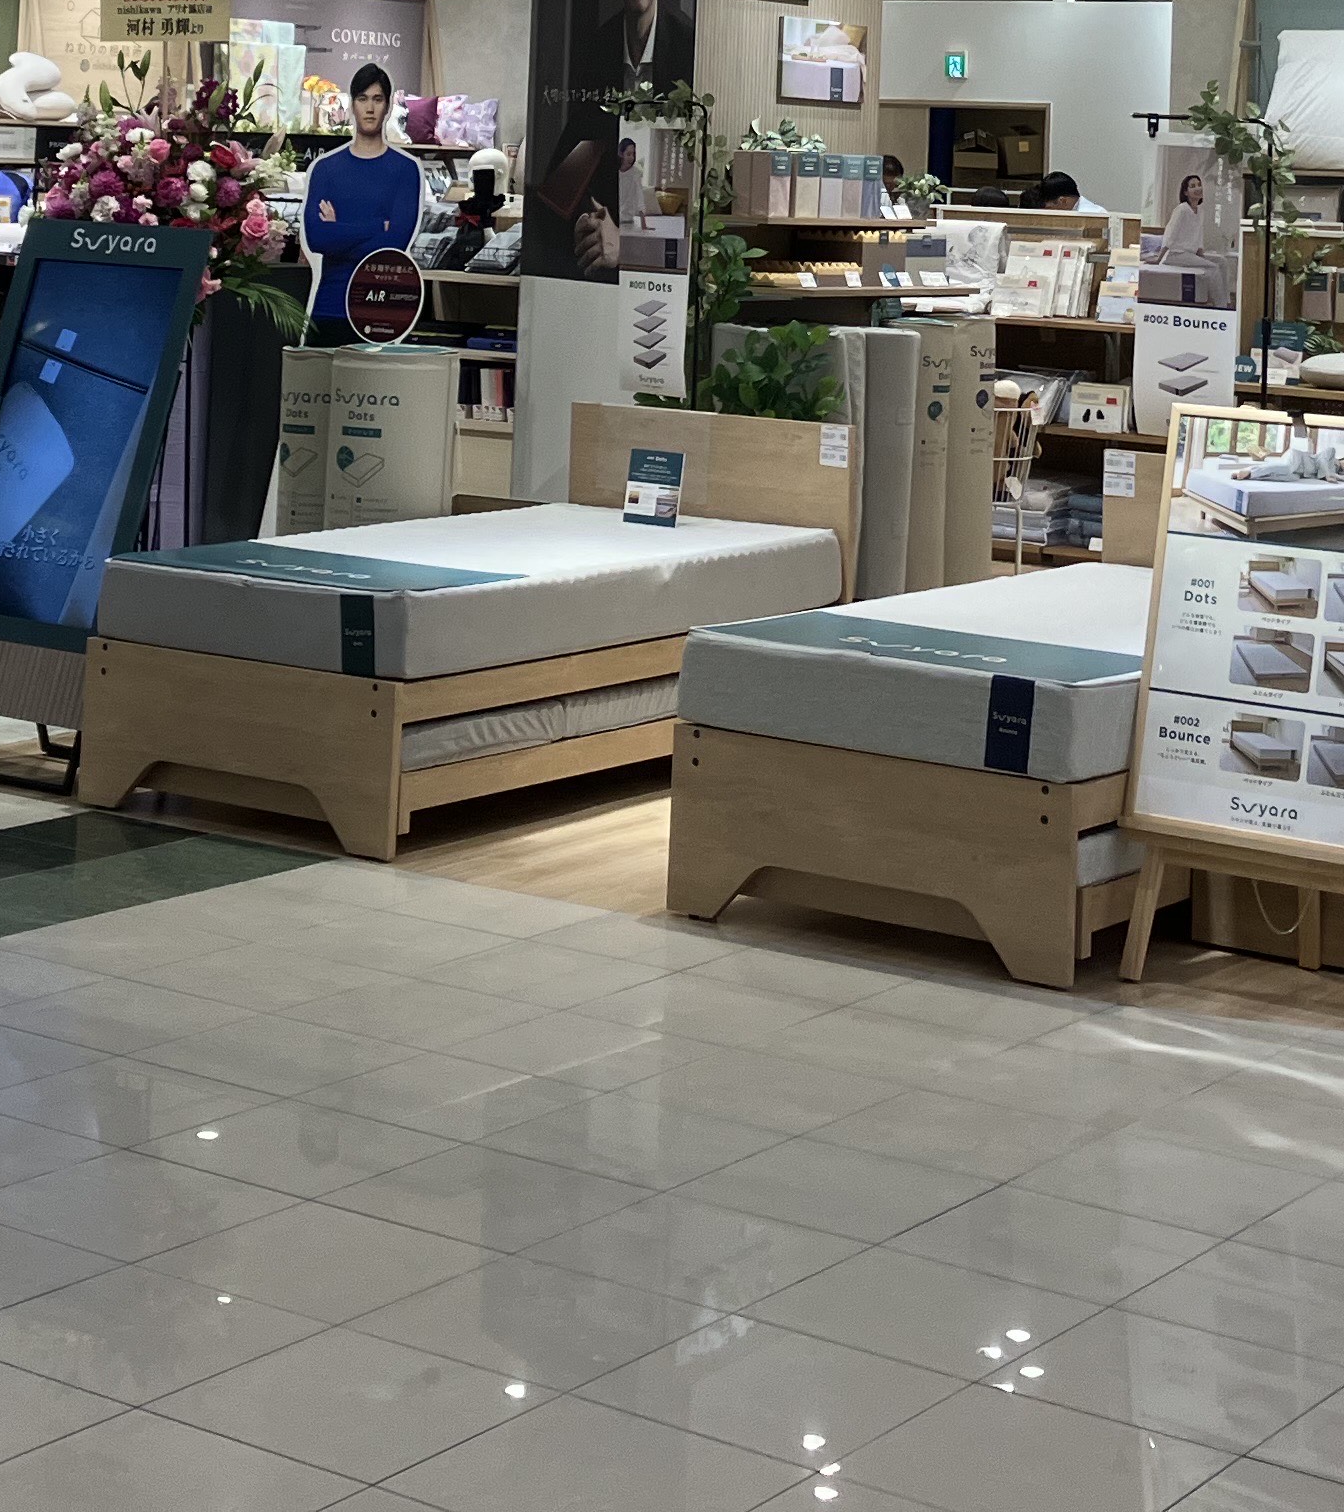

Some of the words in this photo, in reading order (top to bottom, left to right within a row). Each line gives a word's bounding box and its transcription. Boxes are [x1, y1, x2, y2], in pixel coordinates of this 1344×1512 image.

[117, 6, 161, 15] nishikawa
[331, 28, 401, 48] COVERING
[648, 281, 673, 293] Dots
[1143, 314, 1170, 326] #002
[1172, 315, 1228, 332] Bounce
[348, 410, 375, 422] Dots
[21, 524, 60, 546] 小さく
[1190, 578, 1215, 590] #001
[1183, 590, 1218, 605] Dots
[1173, 715, 1201, 728] #002
[1158, 727, 1212, 746] Bounce
